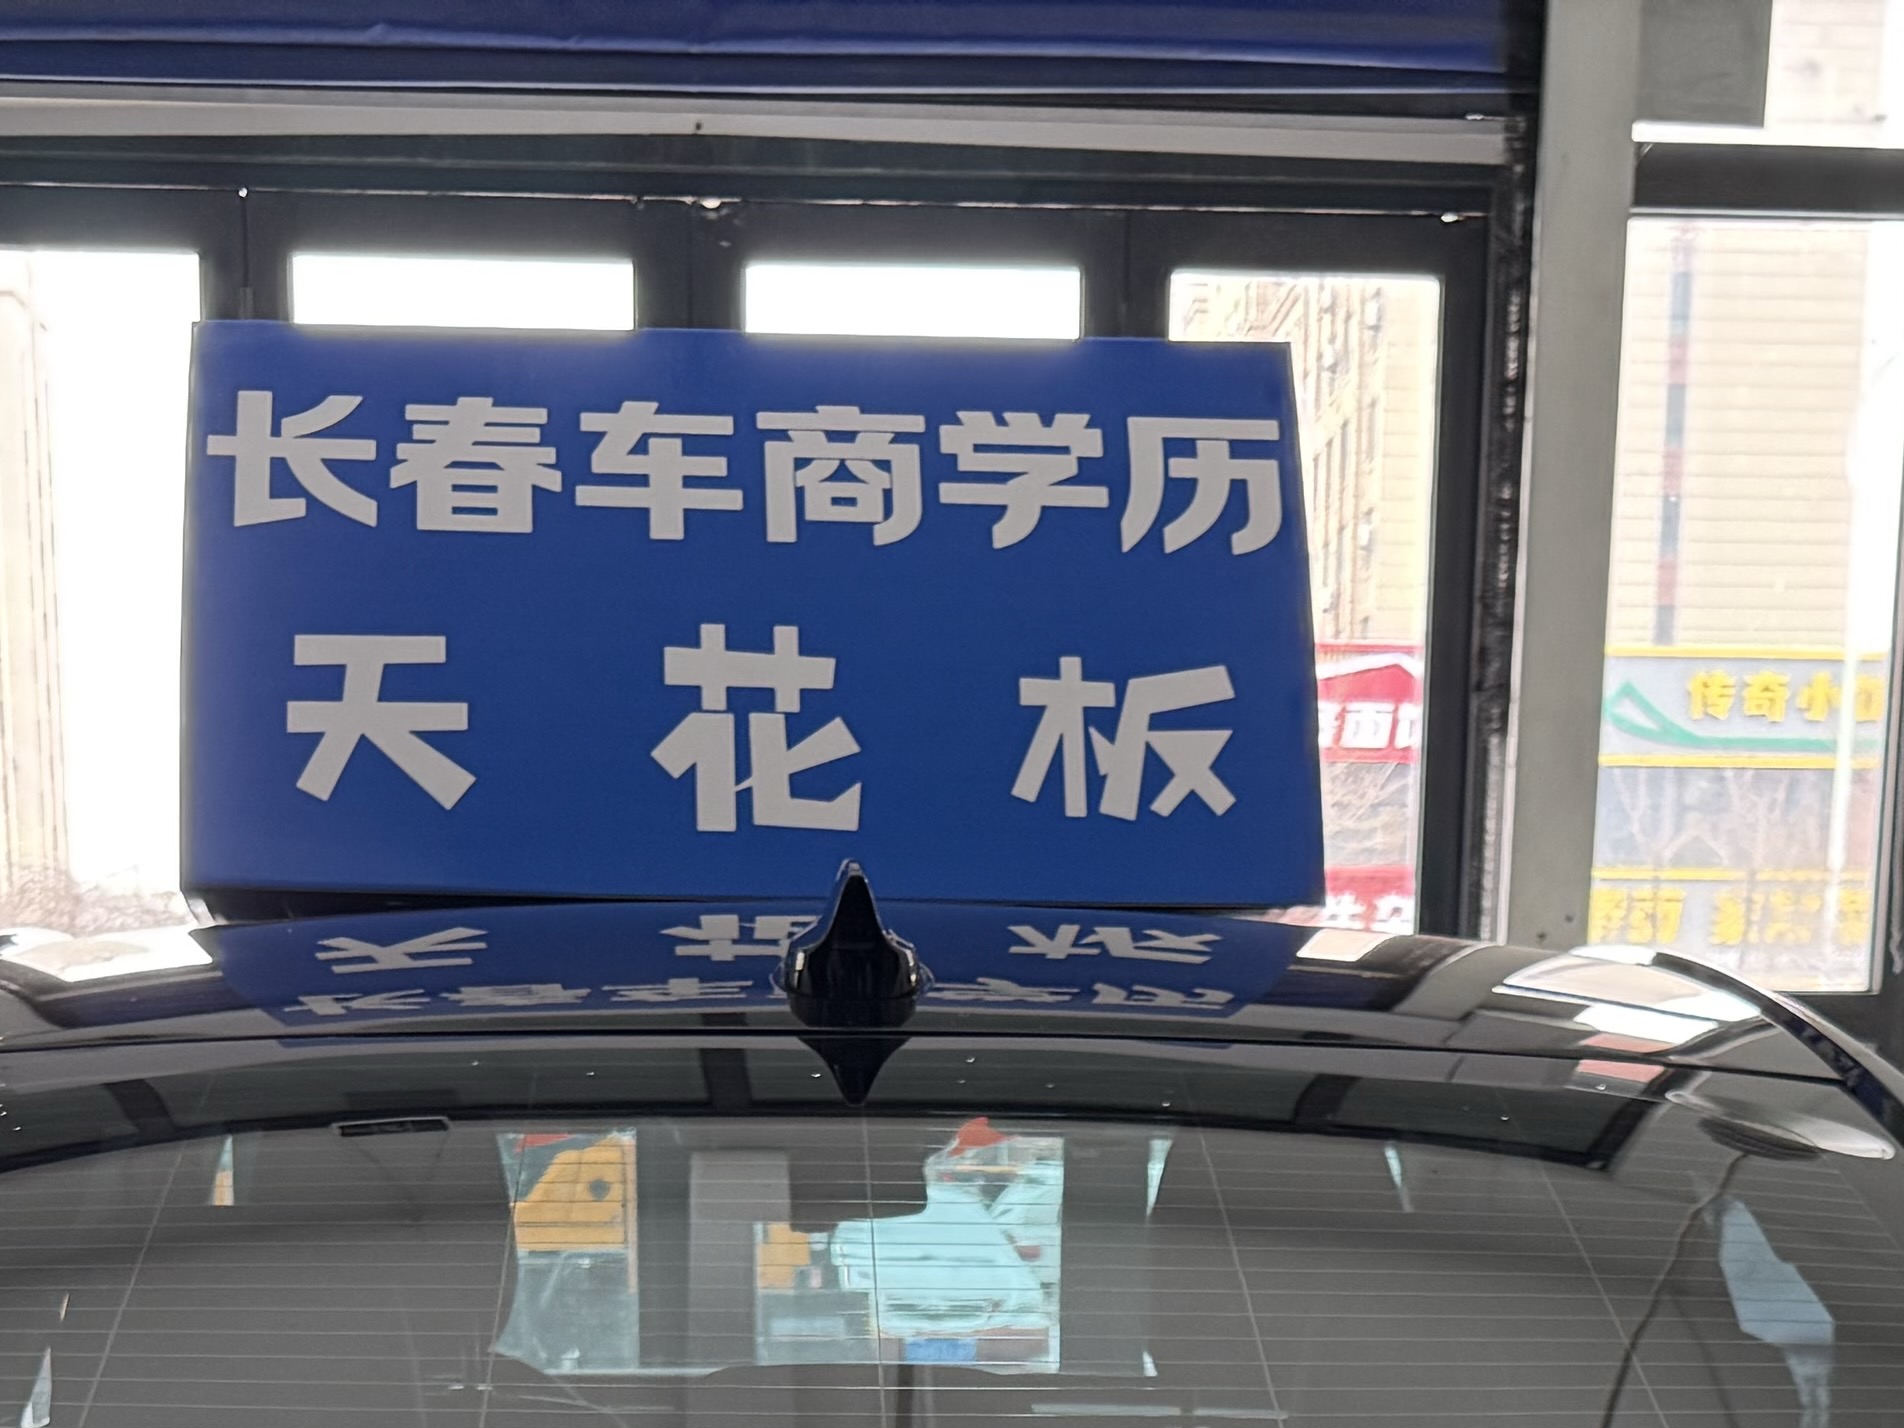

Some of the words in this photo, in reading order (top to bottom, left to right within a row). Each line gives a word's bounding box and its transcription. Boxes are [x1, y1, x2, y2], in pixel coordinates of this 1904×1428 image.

[206, 388, 1286, 556] 长春车商学历
[286, 622, 1237, 833] 天花板
